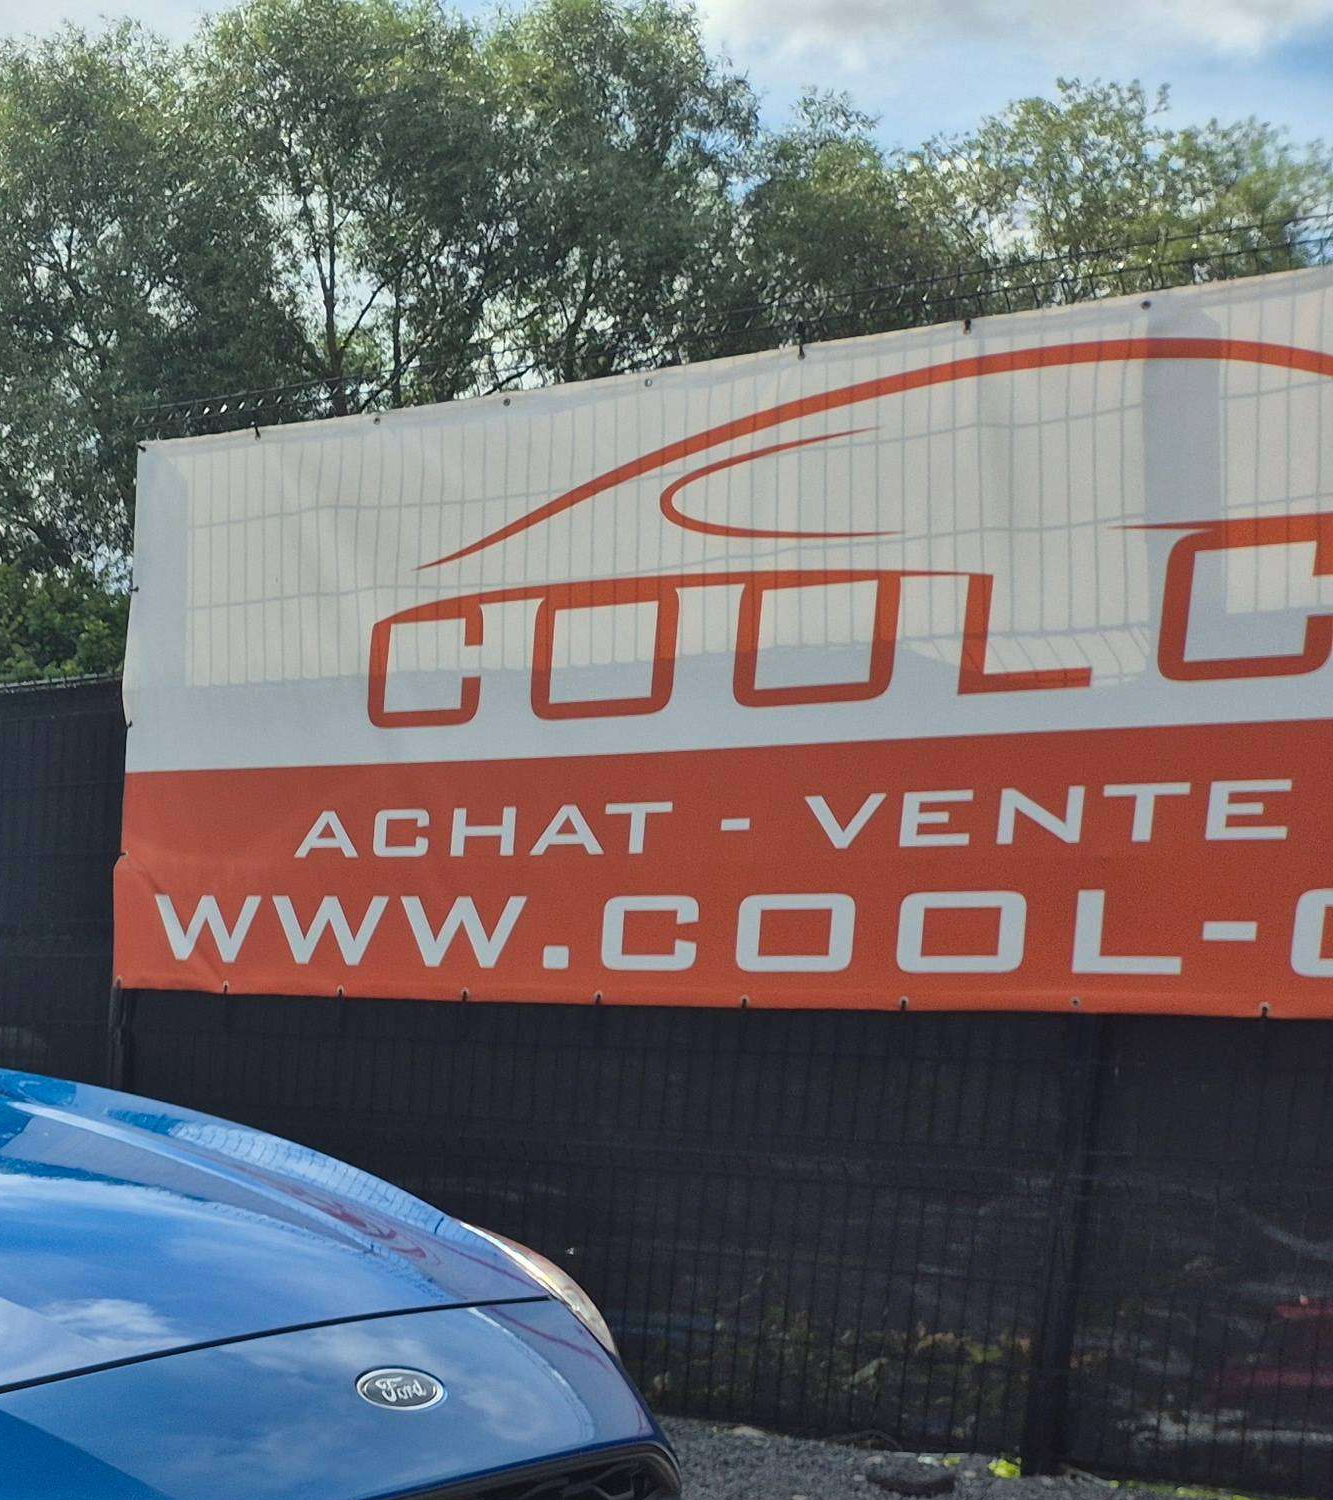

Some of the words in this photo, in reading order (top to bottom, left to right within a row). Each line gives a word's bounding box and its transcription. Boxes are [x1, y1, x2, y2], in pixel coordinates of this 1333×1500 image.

[368, 568, 1093, 729] COOL
[294, 801, 674, 858] ACHAT
[720, 818, 751, 832] -
[805, 778, 1294, 850] VENTE
[374, 1376, 427, 1402] Ford
